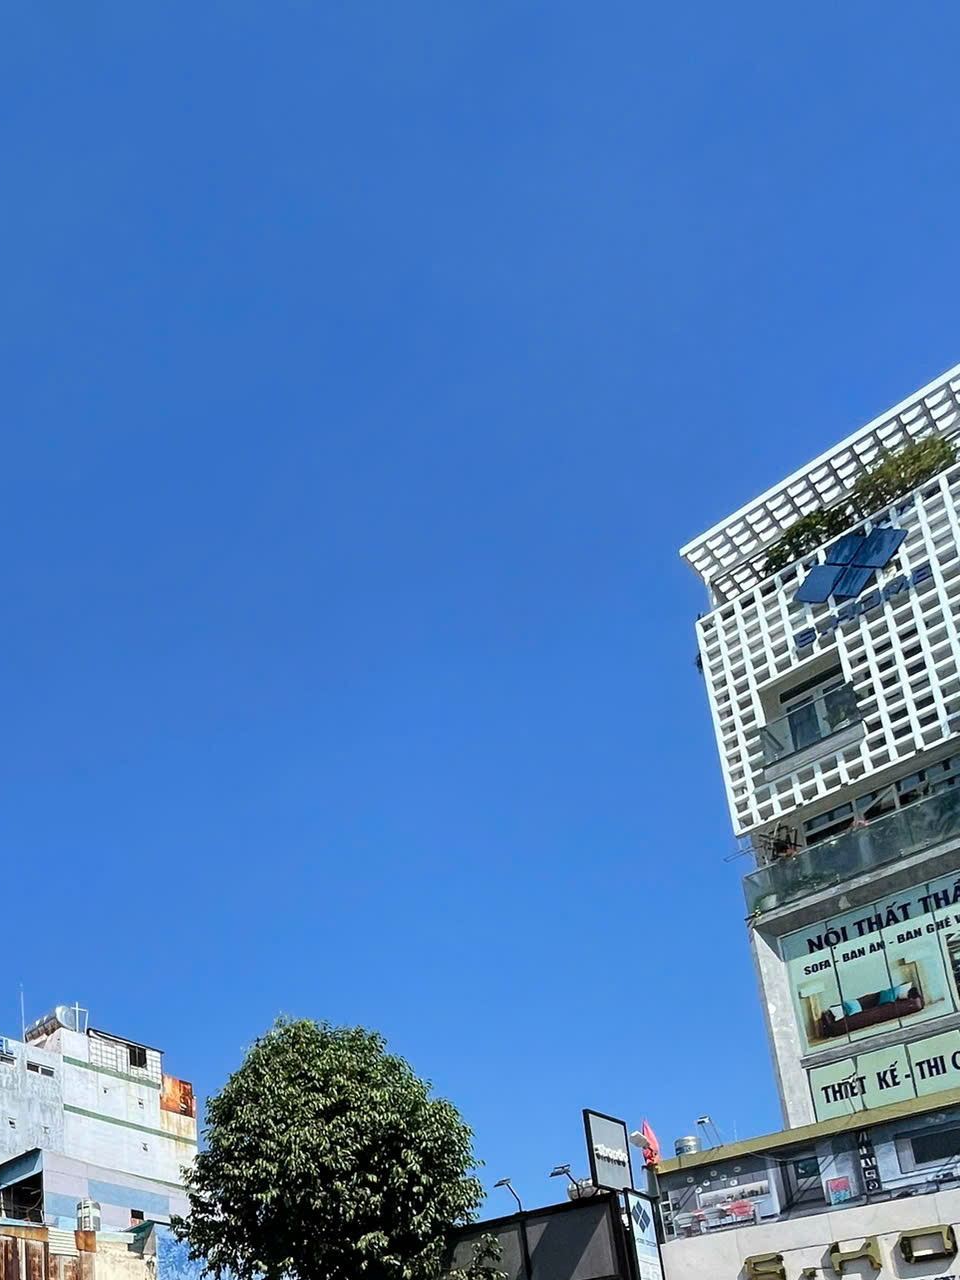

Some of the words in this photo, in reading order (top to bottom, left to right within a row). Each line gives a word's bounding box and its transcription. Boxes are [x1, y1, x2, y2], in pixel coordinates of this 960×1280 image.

[806, 926, 849, 954] NỘI
[853, 901, 911, 937] THẤT
[803, 959, 832, 975] SOFA
[821, 1071, 866, 1103] THIẾT
[876, 1060, 901, 1090] KẾ
[915, 1055, 947, 1079] THI
